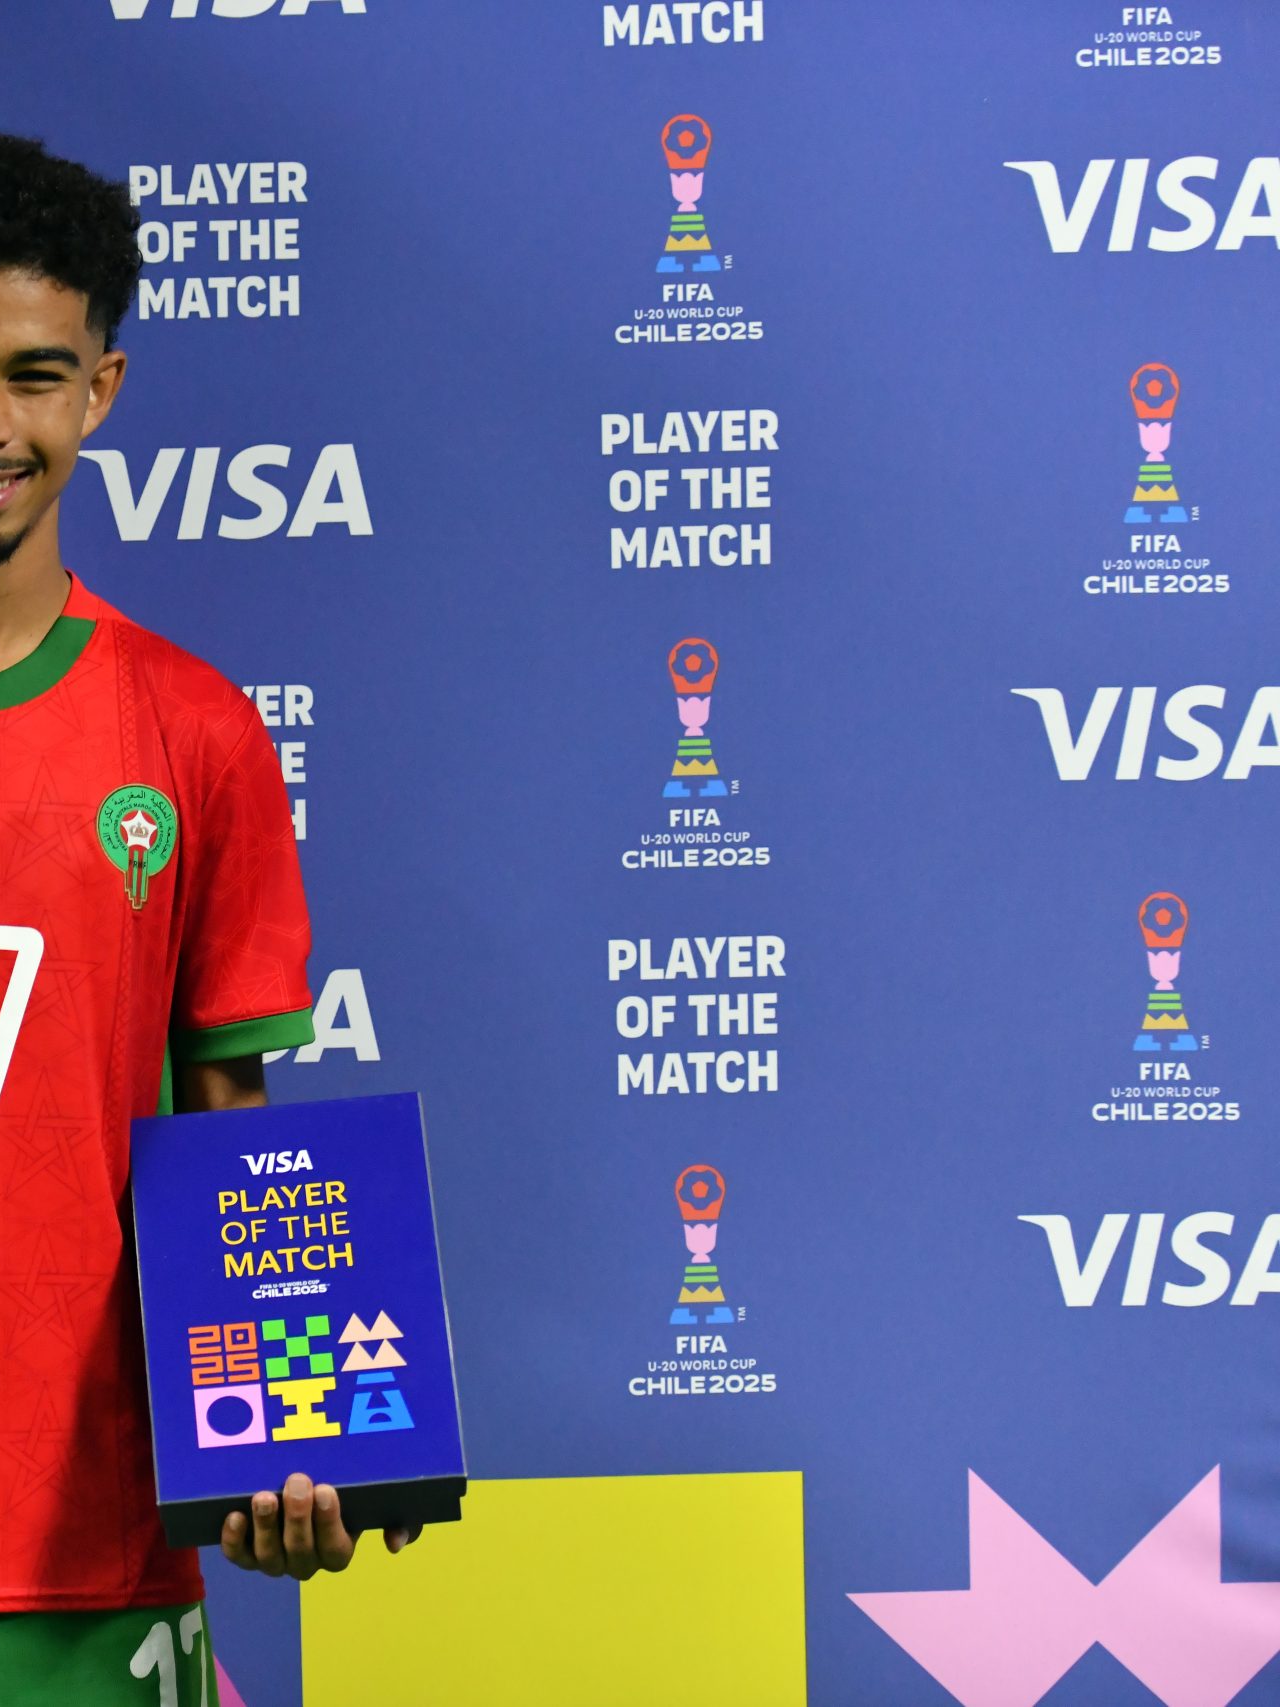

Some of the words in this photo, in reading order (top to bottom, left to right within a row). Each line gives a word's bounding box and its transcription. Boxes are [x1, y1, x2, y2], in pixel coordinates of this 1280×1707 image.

[604, 0, 763, 46] MATCH
[1123, 7, 1172, 25] FIFA
[1095, 33, 1123, 43] U-20
[1127, 31, 1173, 42] WORLD
[1176, 31, 1201, 41] CUP
[130, 162, 307, 205] PLAYER
[1004, 156, 1280, 252] VISA
[137, 221, 197, 263] OF
[209, 219, 299, 260] THE
[139, 276, 299, 319] MATCH
[663, 284, 713, 302] FIFA
[635, 309, 664, 319] U-20
[667, 308, 714, 318] WORLD
[717, 306, 743, 317] CUP
[602, 410, 778, 454] PLAYER
[78, 444, 373, 541] VISA
[610, 470, 669, 512] OF
[681, 467, 770, 509] THE
[611, 524, 770, 568] MATCH
[1132, 535, 1181, 552] FIFA
[1103, 560, 1131, 570] U-20
[1135, 559, 1181, 569] WORLD
[1184, 559, 1210, 569] CUP
[1011, 685, 1280, 780] VISA
[670, 809, 720, 827] FIFA
[642, 834, 670, 844] U-20
[674, 833, 720, 843] WORLD
[724, 832, 750, 842] CUP
[609, 936, 785, 980] PLAYER
[617, 996, 676, 1038] OF
[688, 993, 777, 1035] THE
[618, 1051, 777, 1095] MATCH
[1141, 1063, 1190, 1080] FIFA
[1112, 1087, 1140, 1097] U-20
[1144, 1087, 1191, 1097] WORLD
[1194, 1087, 1220, 1097] CUP
[240, 1150, 313, 1175] VISA
[219, 1181, 347, 1214] PLAYER
[221, 1220, 266, 1245] OF
[279, 1212, 349, 1239] THE
[224, 1243, 353, 1277] MATCH
[677, 1336, 727, 1354] FIFA
[648, 1361, 677, 1371] U-20
[680, 1360, 727, 1370] WORLD
[730, 1359, 756, 1369] CUP
